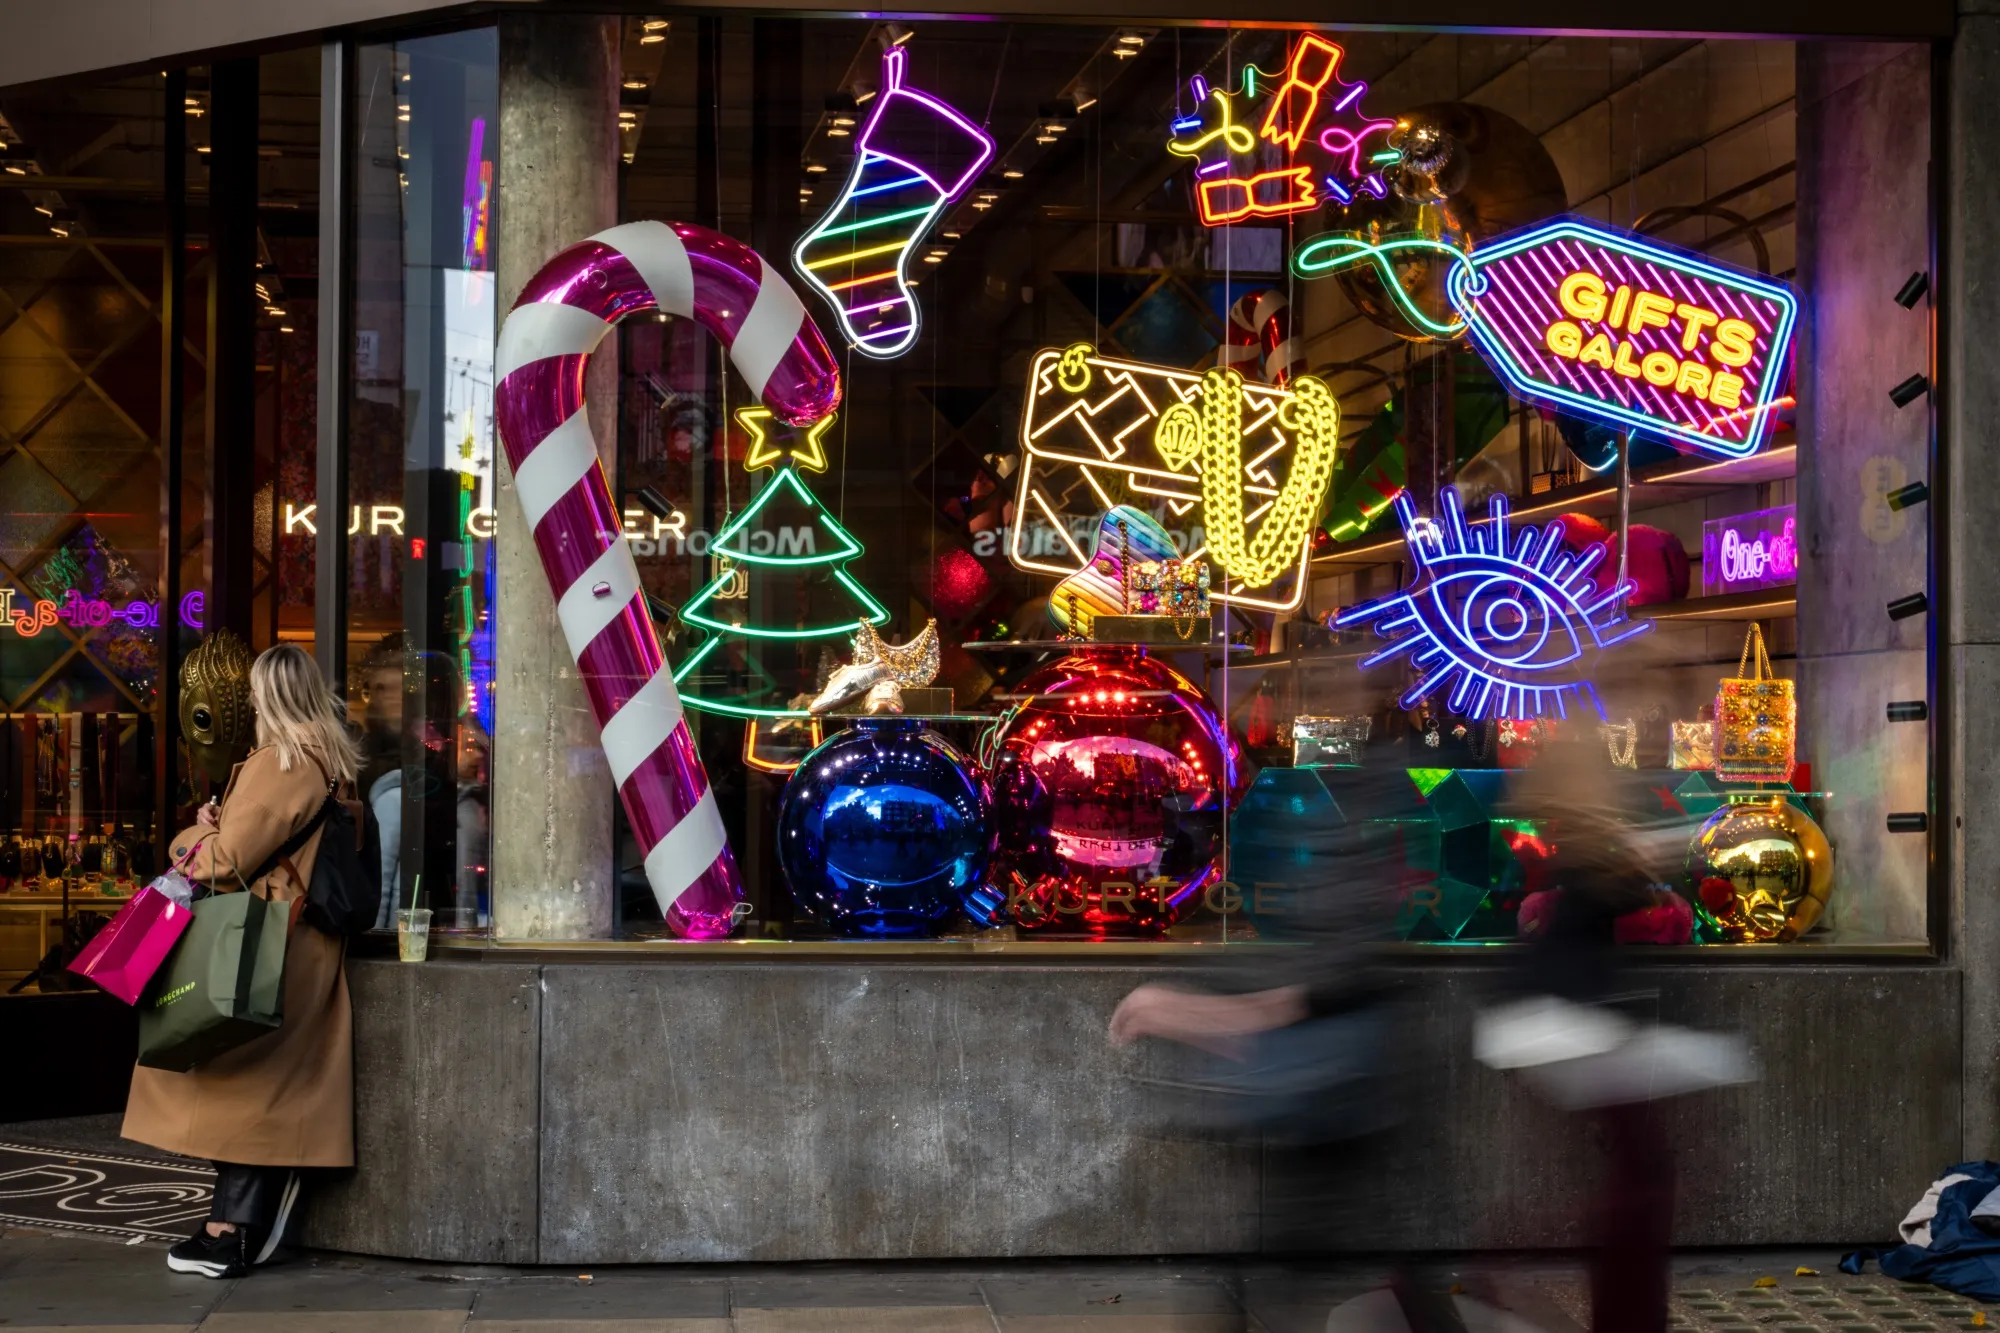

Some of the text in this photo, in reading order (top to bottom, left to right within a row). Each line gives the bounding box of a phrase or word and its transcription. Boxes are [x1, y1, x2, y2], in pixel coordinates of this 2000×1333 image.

[1559, 272, 1757, 367] GIFTS
[1546, 321, 1745, 409] GALORE
[1008, 882, 1444, 918] KURT GER
[156, 981, 196, 1008] LONGCHAMP
